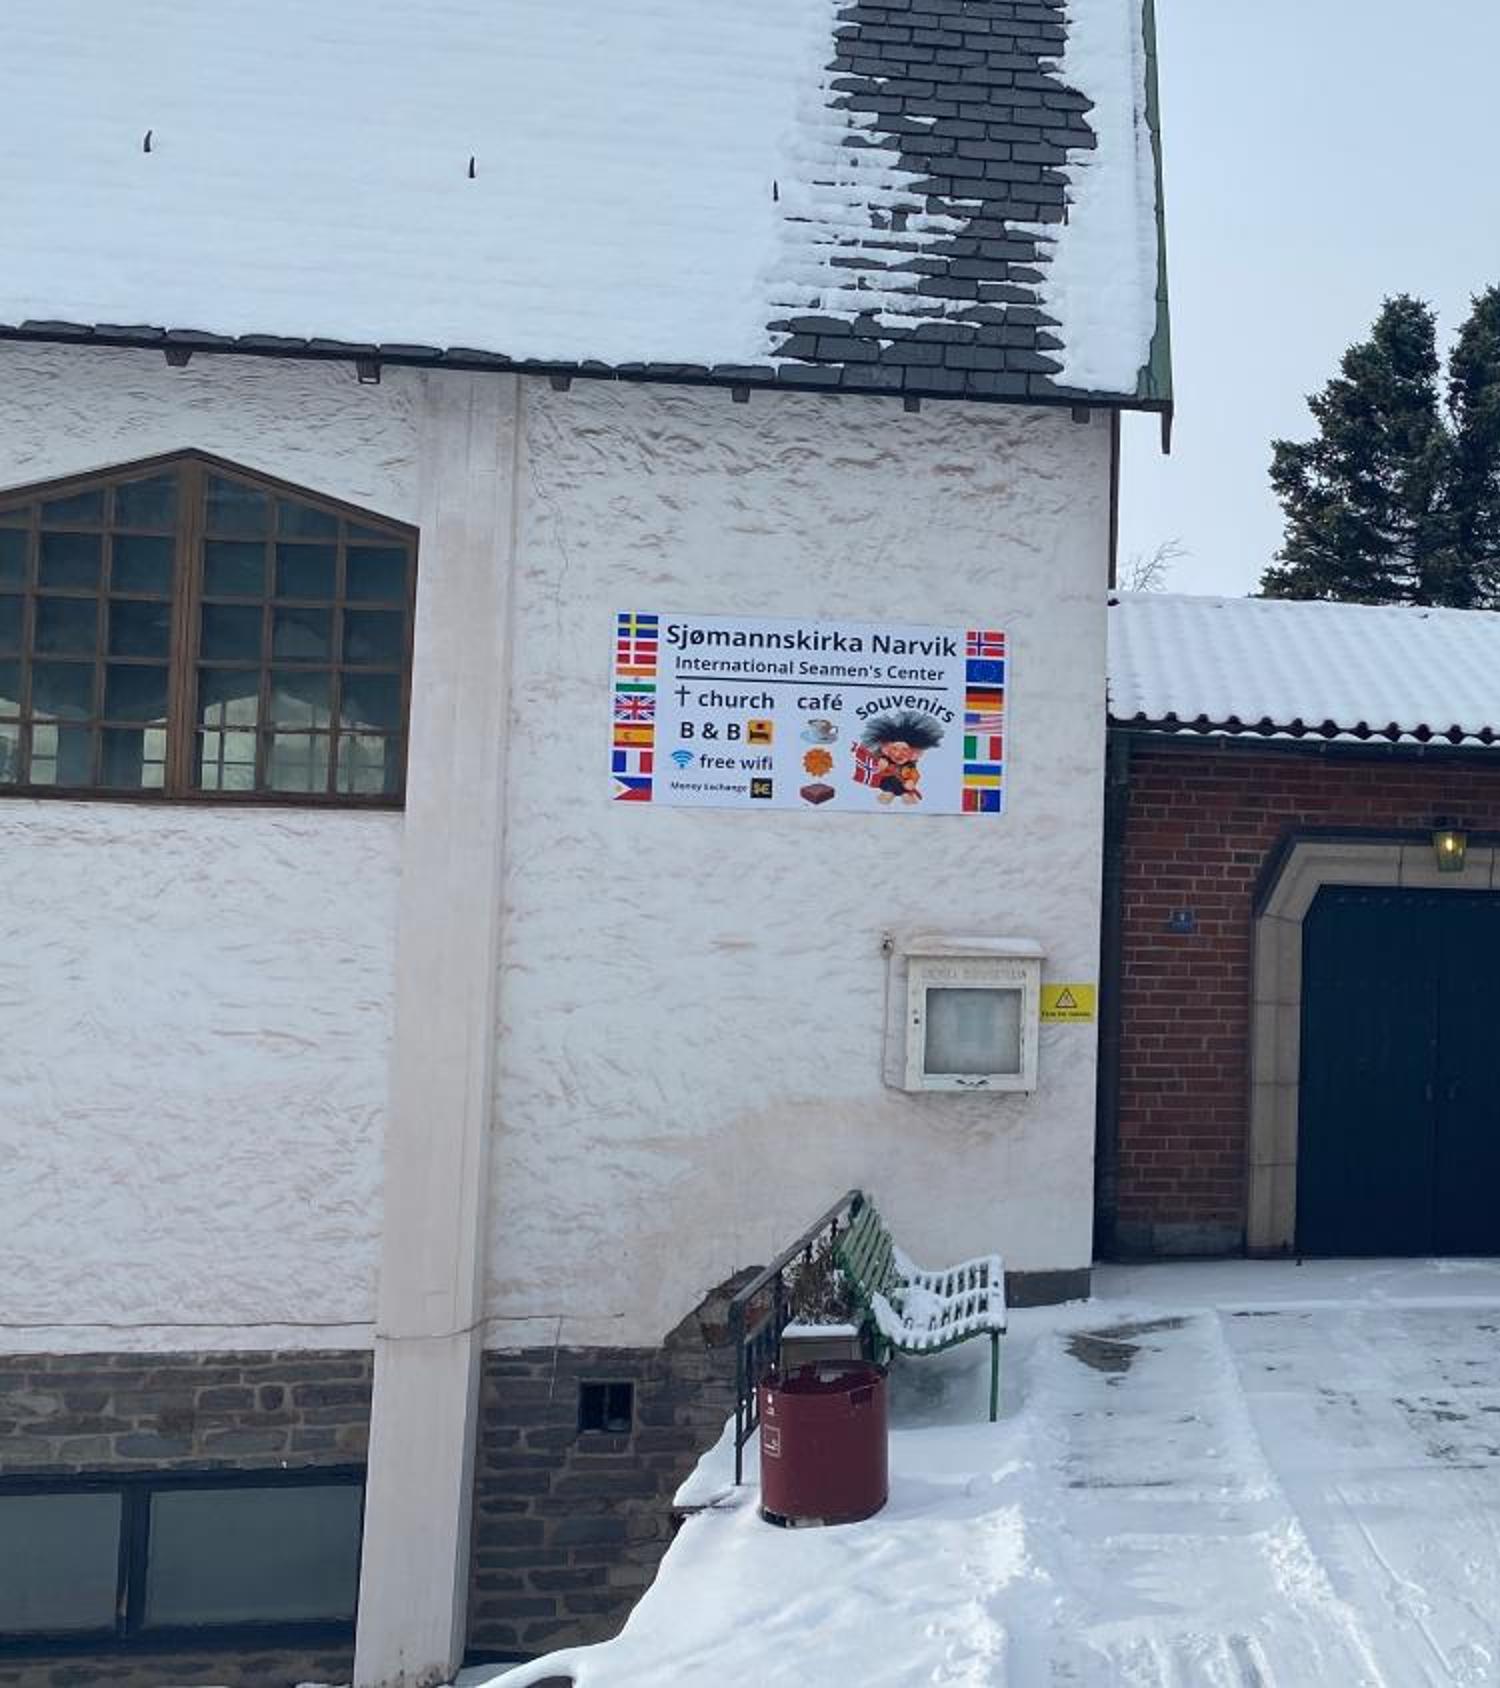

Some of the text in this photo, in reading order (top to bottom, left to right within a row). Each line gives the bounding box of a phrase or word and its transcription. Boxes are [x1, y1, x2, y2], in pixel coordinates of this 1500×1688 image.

[666, 624, 957, 656] Sjømannskirka Narvik
[675, 656, 944, 680] International Seamen's Center
[698, 690, 774, 709] church
[797, 693, 843, 711] café
[855, 695, 955, 723] souvenirs
[681, 721, 741, 740] B & B
[700, 754, 773, 770] free wifi
[671, 781, 747, 792] Money Exchange
